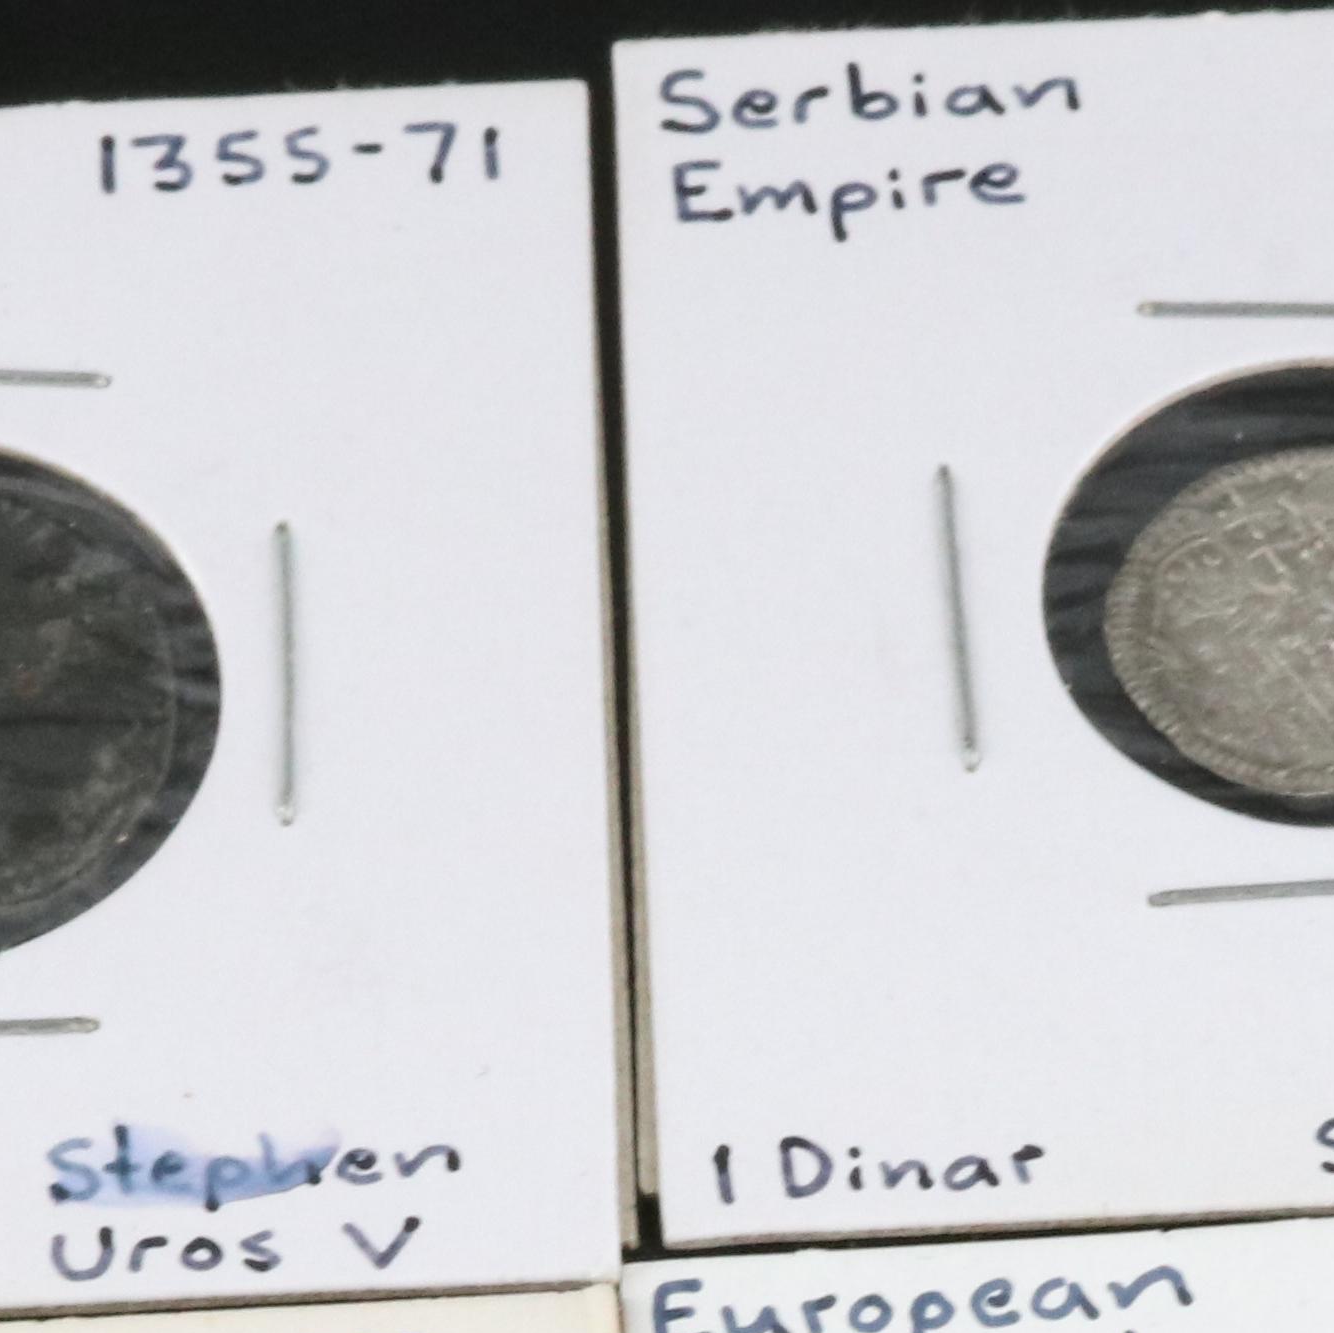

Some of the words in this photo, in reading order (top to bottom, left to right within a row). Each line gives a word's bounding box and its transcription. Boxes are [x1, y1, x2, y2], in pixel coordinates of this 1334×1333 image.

[660, 62, 1081, 135] Serbian
[100, 122, 499, 194] 1355-71
[672, 160, 1025, 243] Empire
[47, 1124, 461, 1212] Stephen
[779, 1136, 1045, 1199] Dinar
[51, 1225, 281, 1282] Uros
[343, 1216, 421, 1269] V
